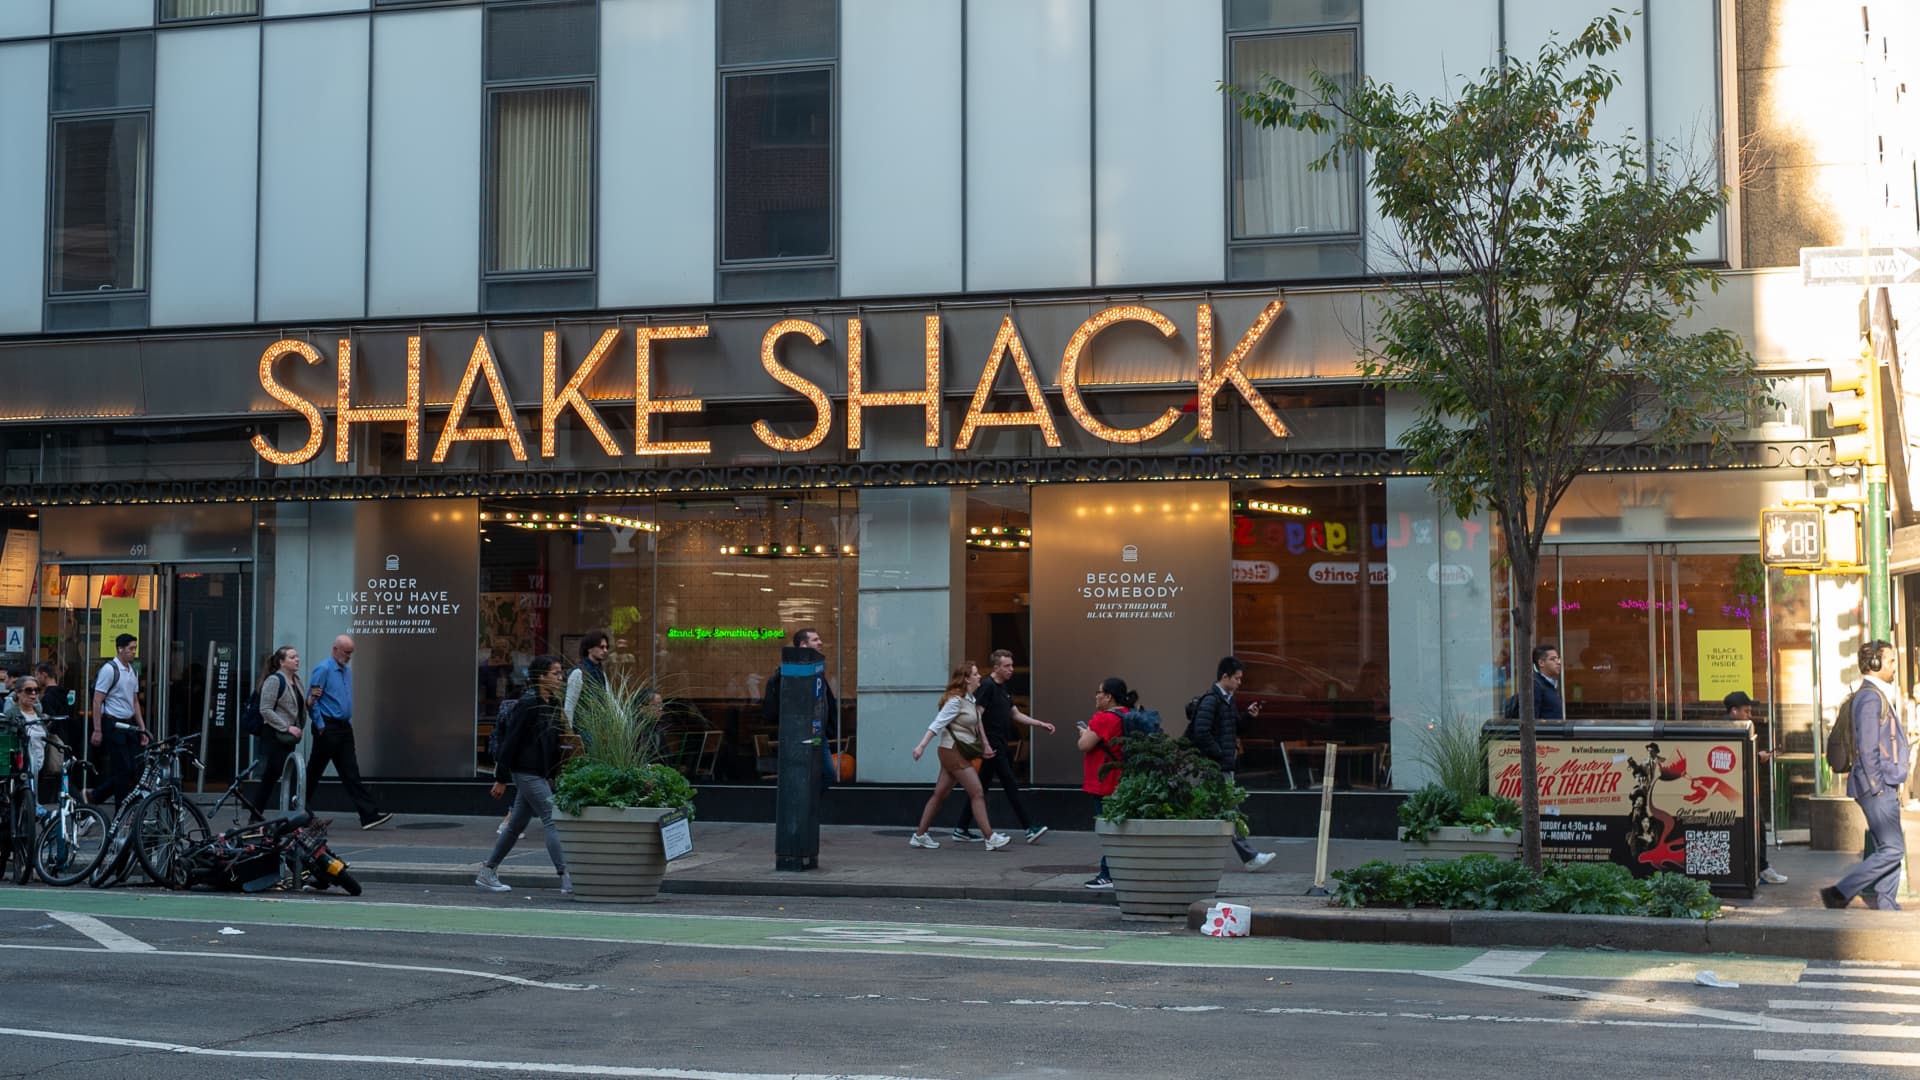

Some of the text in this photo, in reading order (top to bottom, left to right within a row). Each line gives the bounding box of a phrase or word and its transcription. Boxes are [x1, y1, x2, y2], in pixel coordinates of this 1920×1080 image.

[1874, 257, 1910, 273] WAY
[251, 299, 1293, 466] SHAKE SHACK
[338, 476, 434, 498] FROZEN
[562, 470, 658, 494] FLOATS
[665, 466, 756, 491] CONES
[765, 464, 821, 489] HOT
[825, 461, 902, 487] DOGS
[911, 457, 1078, 483] CONCRETES
[1086, 456, 1161, 480] SODA
[1174, 453, 1248, 478] FRIES
[1259, 450, 1391, 477] BURGERS
[1767, 444, 1856, 468] DOG
[130, 544, 147, 556] 691
[368, 578, 417, 589] ORDER
[1086, 572, 1175, 584] BECOME A
[337, 591, 448, 602] LIKE YOU HAVE
[1078, 586, 1184, 598] 'SOMEBODY'
[408, 604, 460, 615] MONEY
[1095, 602, 1168, 610] THAT'S TRIED OUR
[1086, 611, 1175, 619] BLACK TRUFFLE MENU
[9, 630, 21, 646] A
[668, 627, 693, 638] Stand
[713, 627, 760, 640] Something
[216, 661, 229, 726] ENTER HERE
[1553, 758, 1613, 778] Mystery
[1497, 771, 1622, 798] DINER THEATER
[1709, 810, 1737, 825] NOW!
